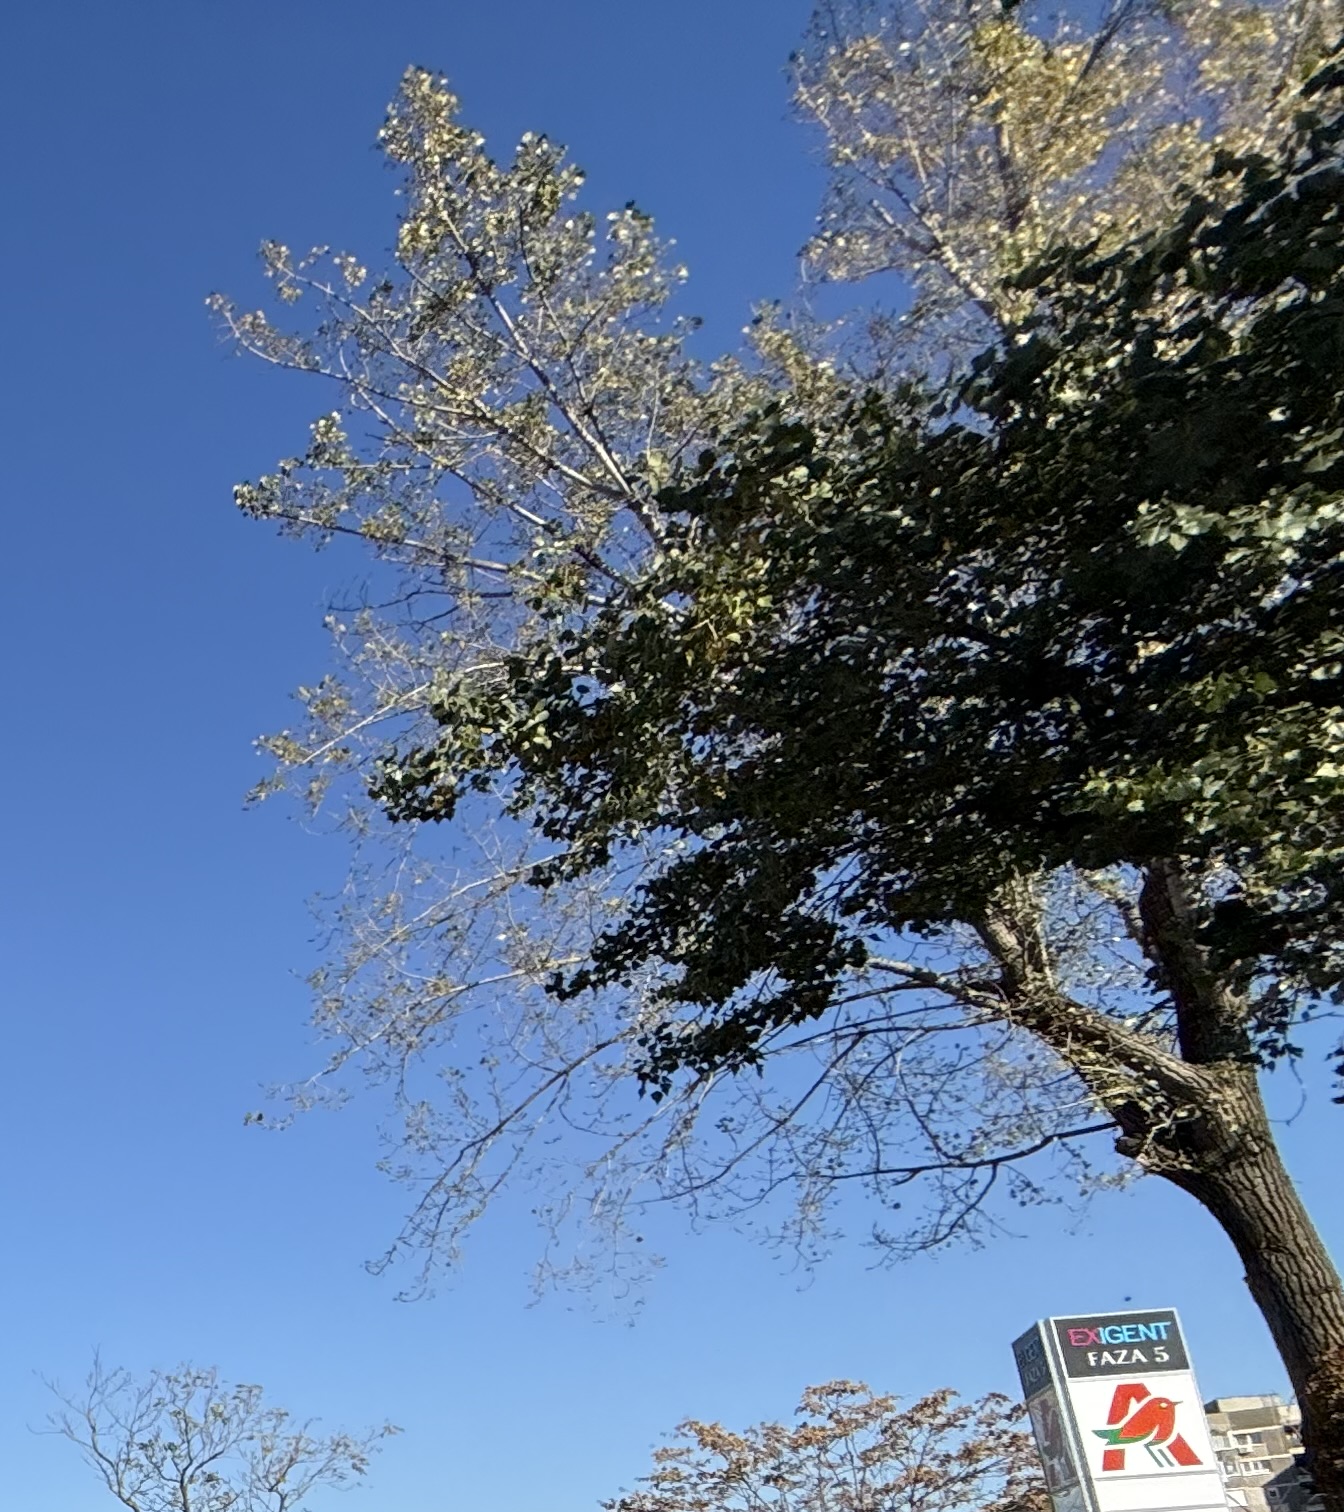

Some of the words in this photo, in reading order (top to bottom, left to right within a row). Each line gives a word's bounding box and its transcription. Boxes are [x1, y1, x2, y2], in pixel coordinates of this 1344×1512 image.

[1067, 1321, 1171, 1347] EXIGENT
[1087, 1349, 1148, 1366] FAZA
[1153, 1346, 1170, 1363] 5
